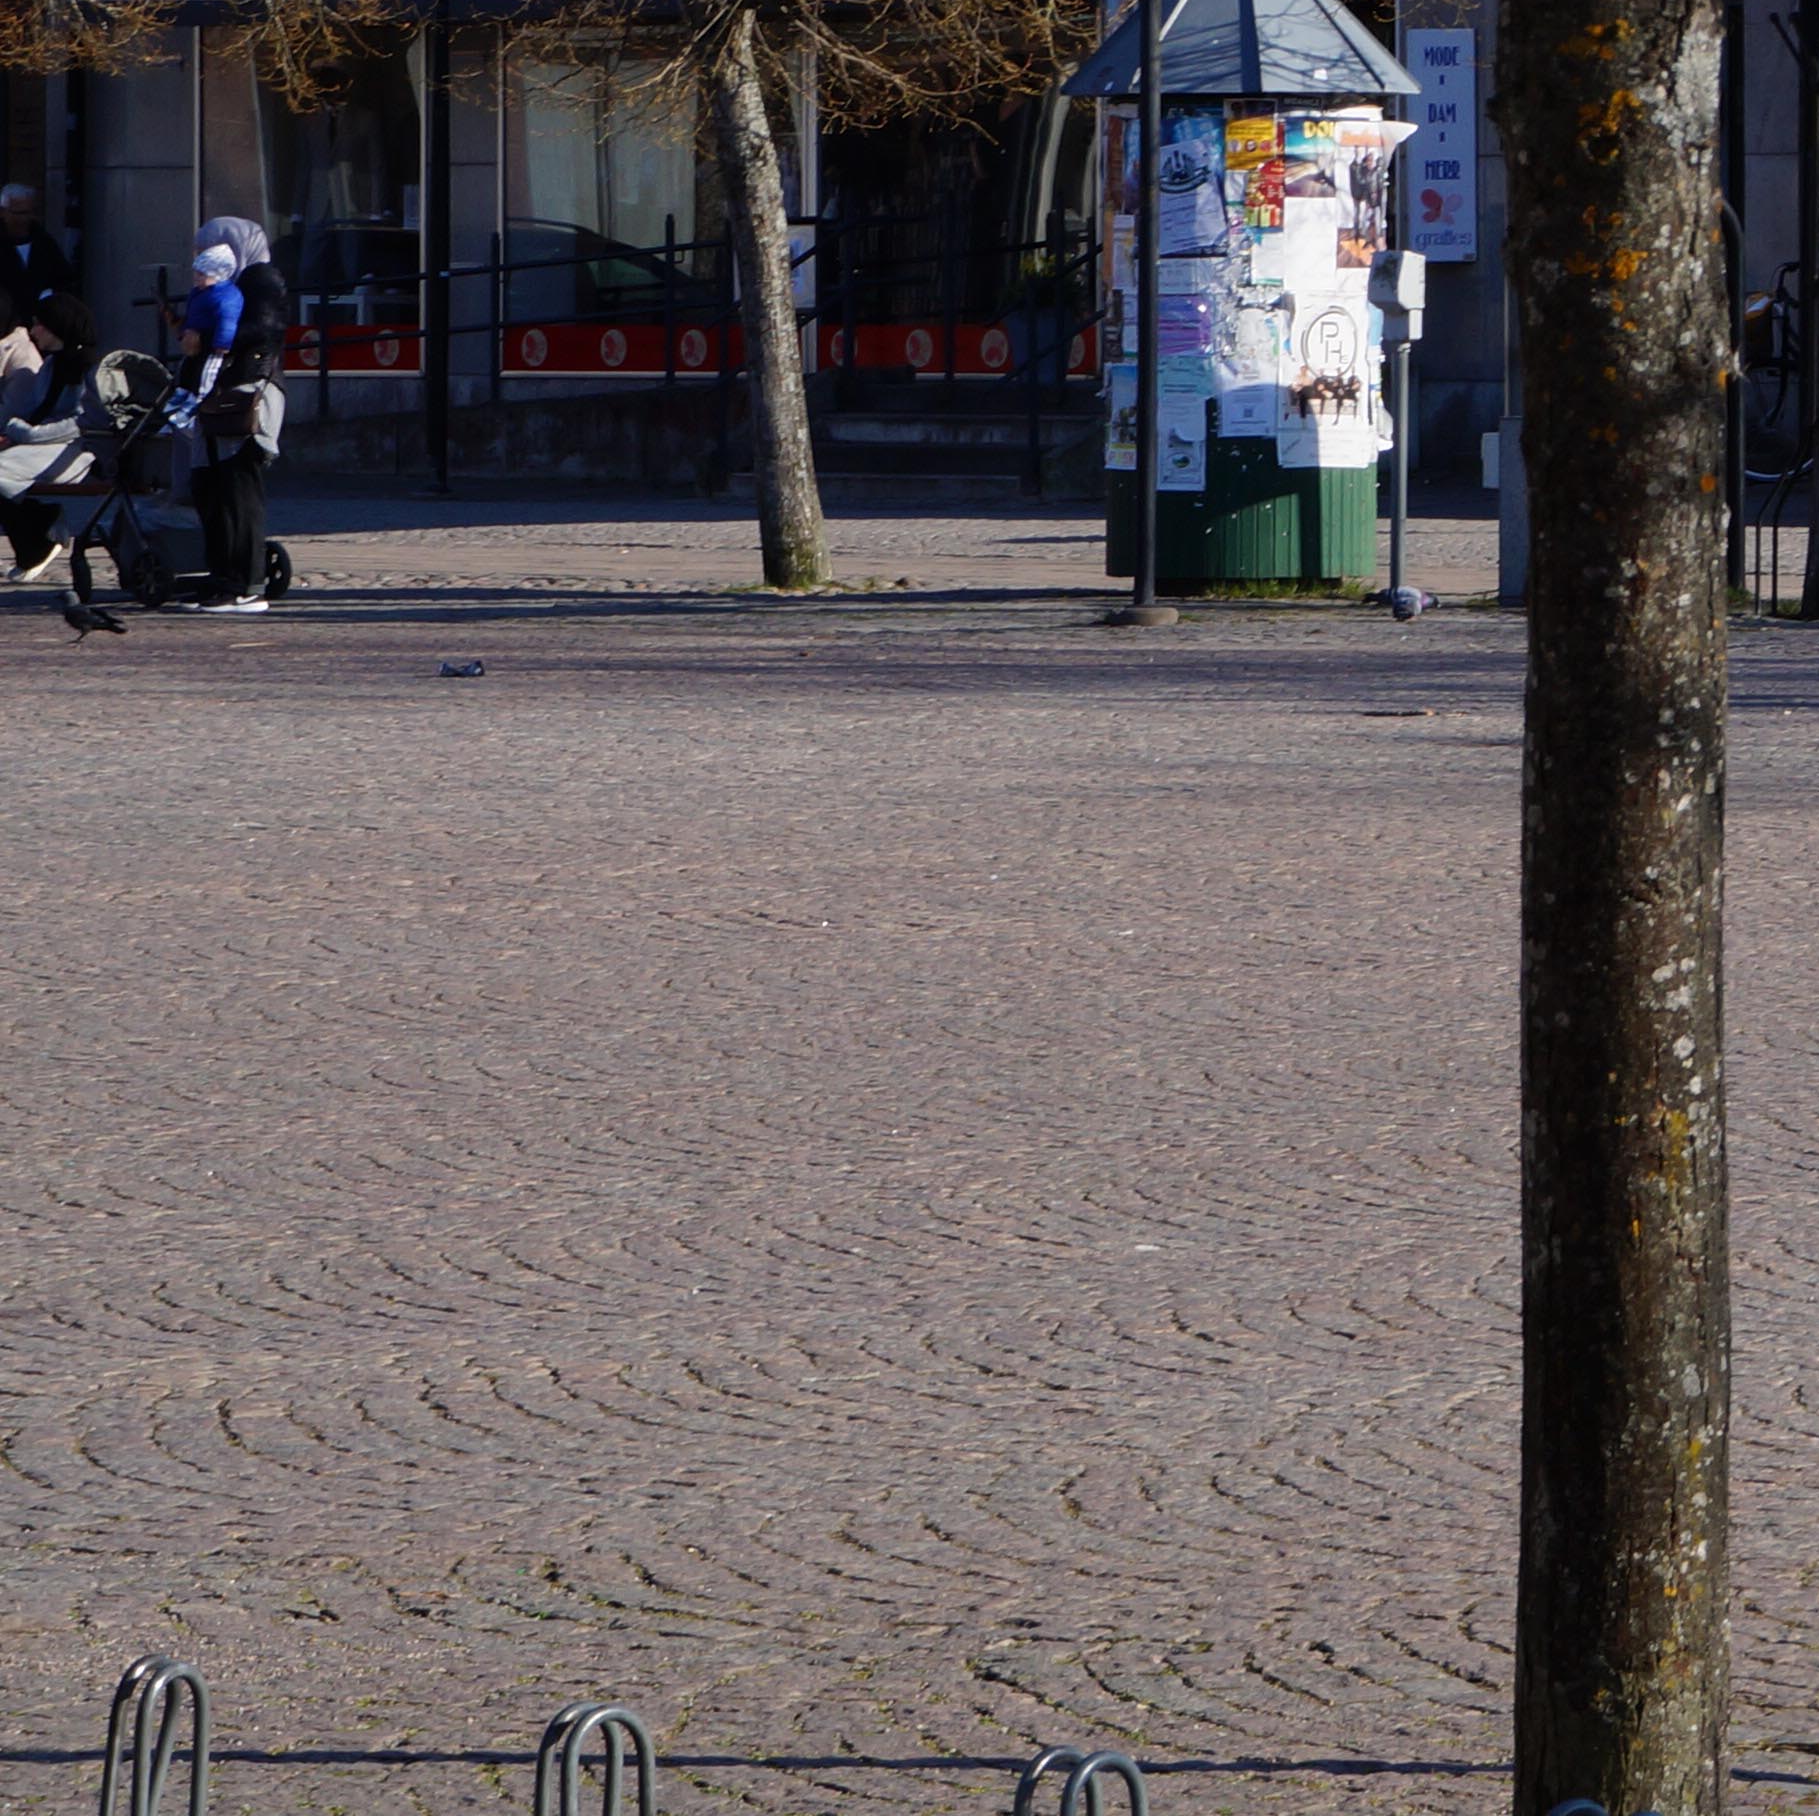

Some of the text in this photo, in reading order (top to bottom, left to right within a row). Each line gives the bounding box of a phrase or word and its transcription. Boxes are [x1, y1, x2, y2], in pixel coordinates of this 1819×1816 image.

[1424, 45, 1461, 67] MODE
[1428, 103, 1457, 124] DAM
[1424, 160, 1461, 181] HERR
